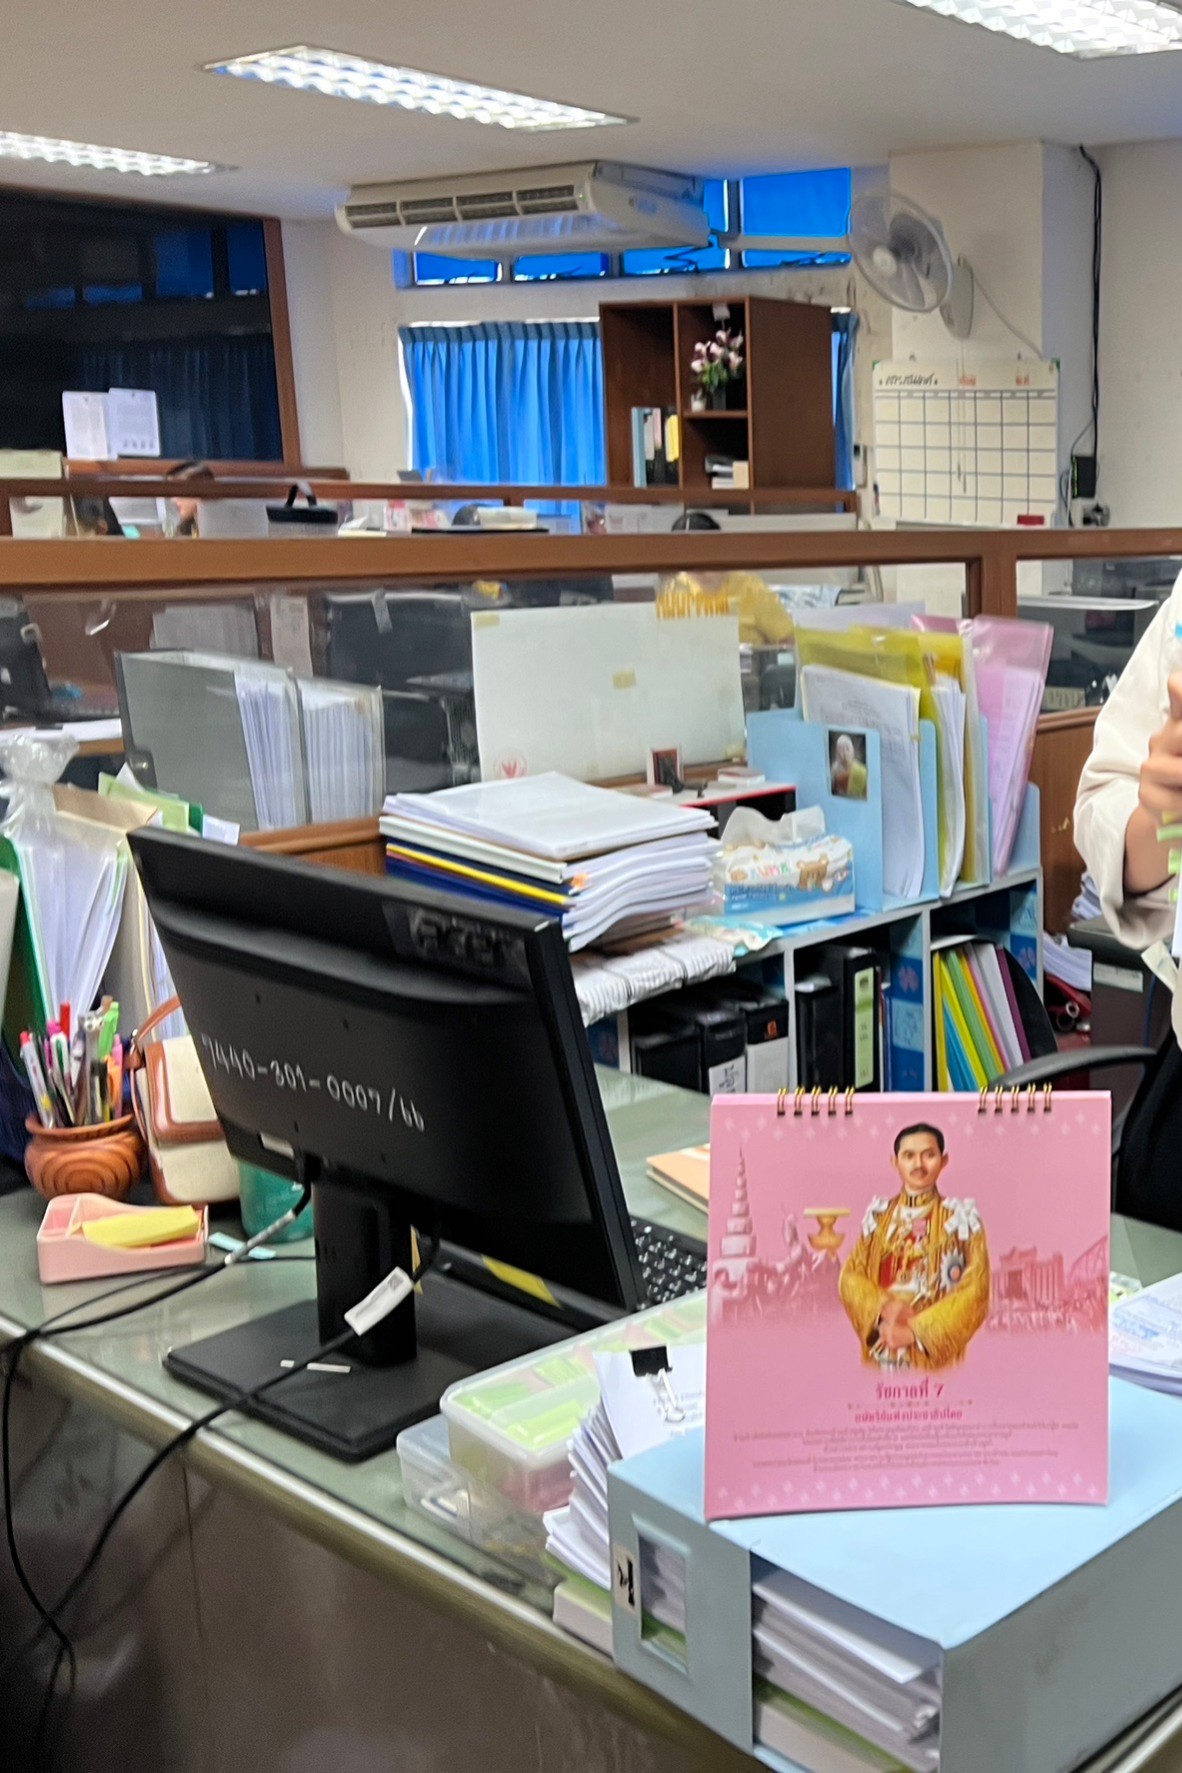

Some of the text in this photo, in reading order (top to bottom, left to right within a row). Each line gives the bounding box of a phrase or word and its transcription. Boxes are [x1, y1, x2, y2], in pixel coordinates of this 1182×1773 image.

[876, 1376, 944, 1399] รัชกาลที่ 7
